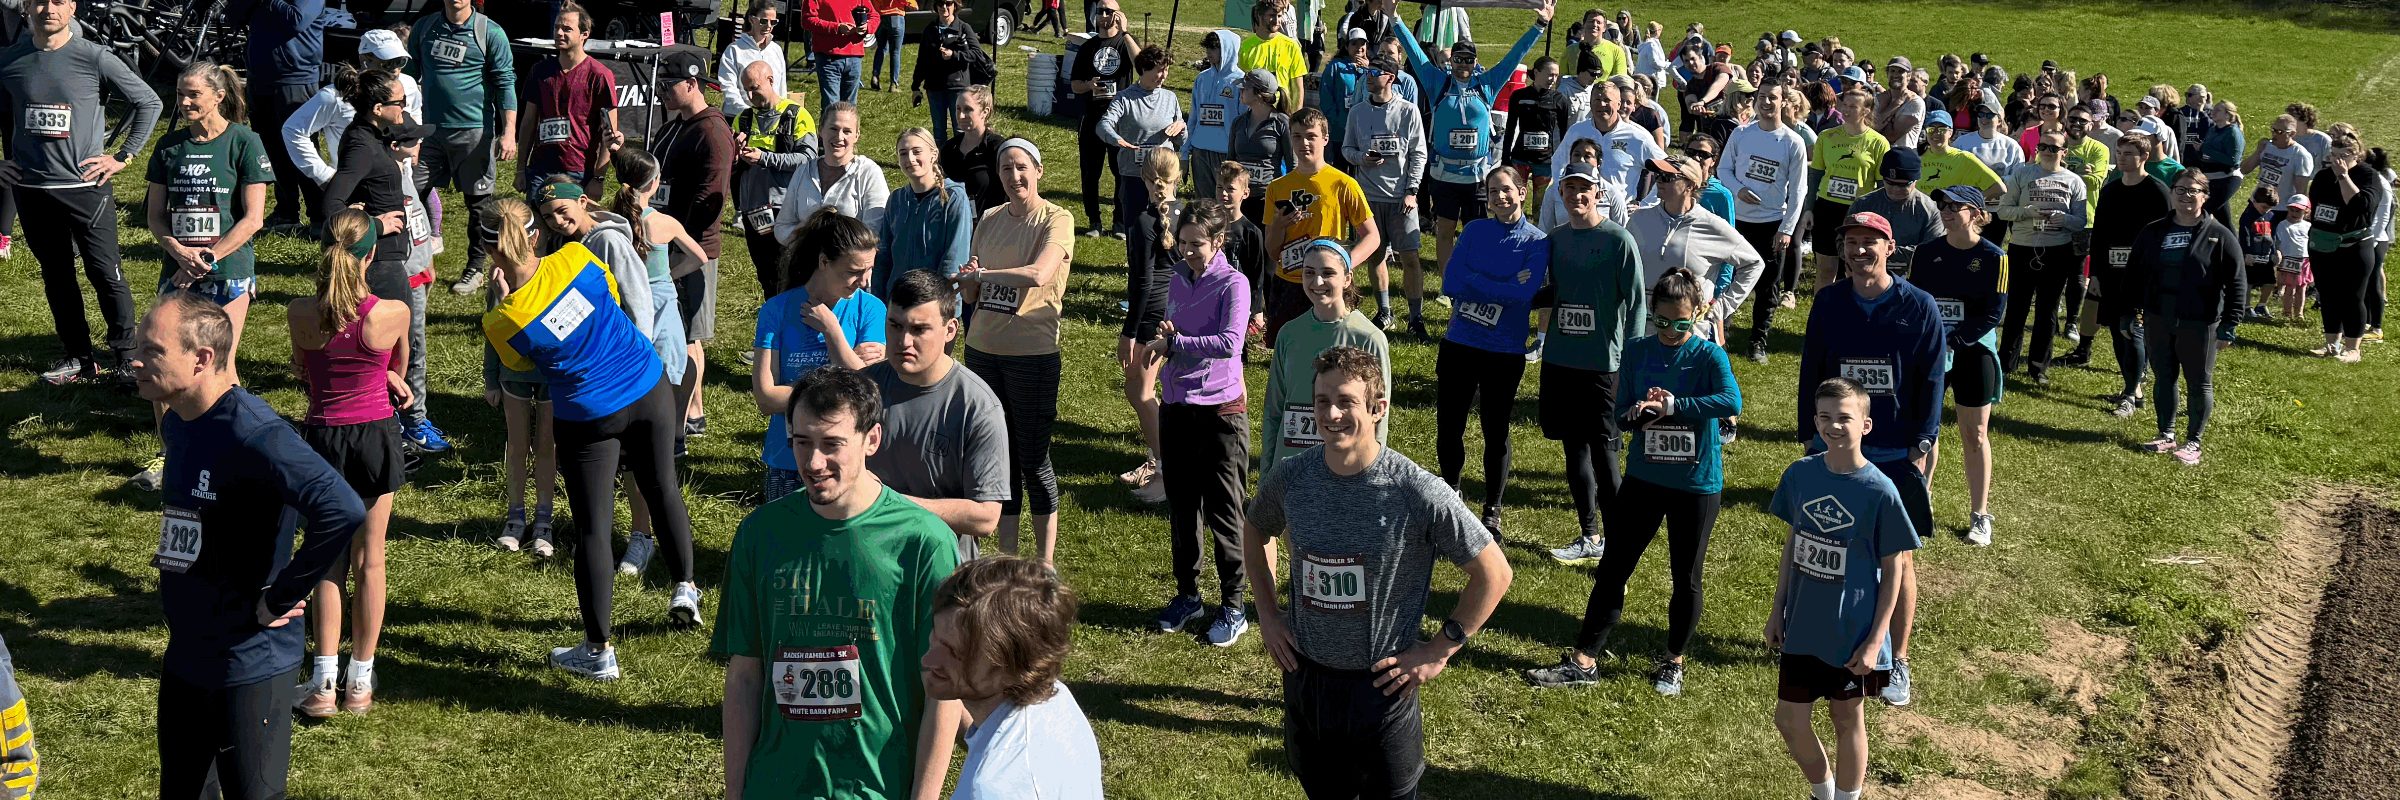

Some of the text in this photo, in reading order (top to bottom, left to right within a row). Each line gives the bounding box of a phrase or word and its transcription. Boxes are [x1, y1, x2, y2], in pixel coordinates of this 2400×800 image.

[443, 44, 461, 57] 178
[37, 112, 67, 127] 333
[1208, 110, 1223, 120] 326
[547, 123, 569, 136] 328
[1460, 134, 1475, 144] 201
[1757, 164, 1776, 178] 332
[1838, 185, 1855, 195] 238
[2320, 209, 2335, 219] 243
[185, 217, 214, 233] 314
[991, 284, 1017, 303] 295
[1473, 302, 1497, 320] 199
[1938, 304, 1961, 318] 254
[1567, 311, 1592, 327] 200
[1857, 367, 1889, 386] 335
[1658, 434, 1692, 453] 306
[198, 470, 210, 491] S
[191, 488, 216, 500] SYRACUSE
[169, 523, 199, 555] 292
[1807, 544, 1841, 571] 240
[1319, 570, 1358, 596] 310
[788, 621, 810, 638] WAY
[783, 650, 848, 659] RADISH RAMBLER 5K
[800, 668, 854, 699] 288
[789, 707, 809, 715] WHITE
[828, 707, 848, 715] FARM
